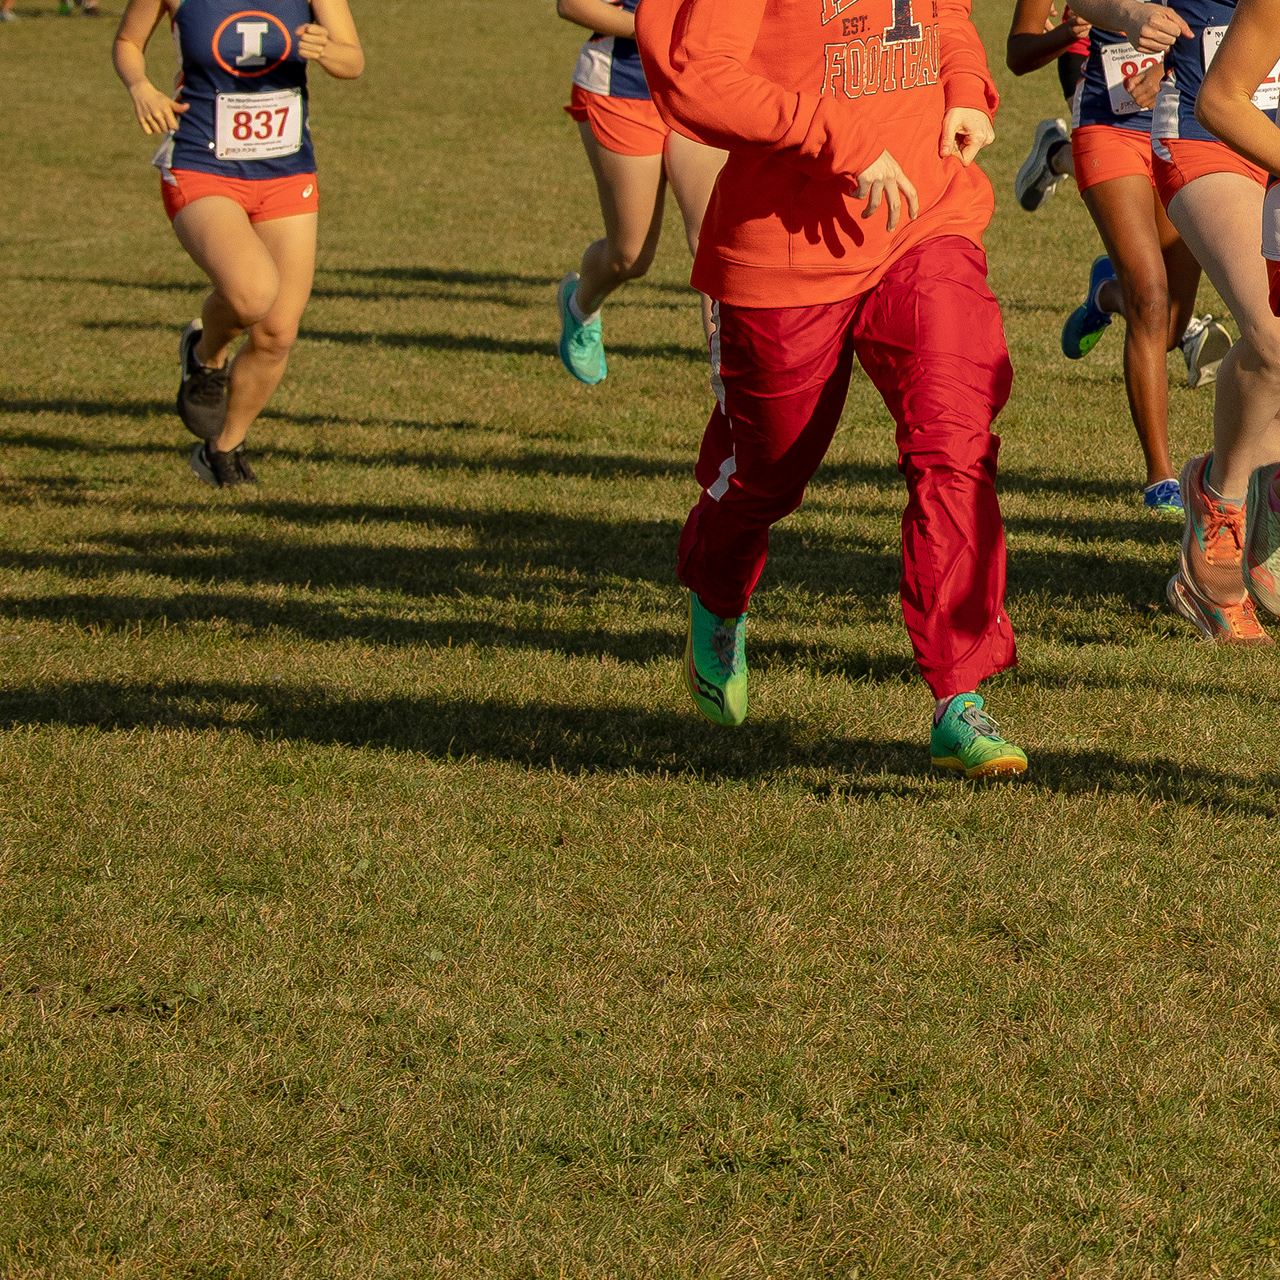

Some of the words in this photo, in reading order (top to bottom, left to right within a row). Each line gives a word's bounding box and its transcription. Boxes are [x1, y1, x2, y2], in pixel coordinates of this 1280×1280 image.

[842, 15, 871, 37] EST.
[236, 22, 268, 66] I
[232, 106, 290, 141] 837
